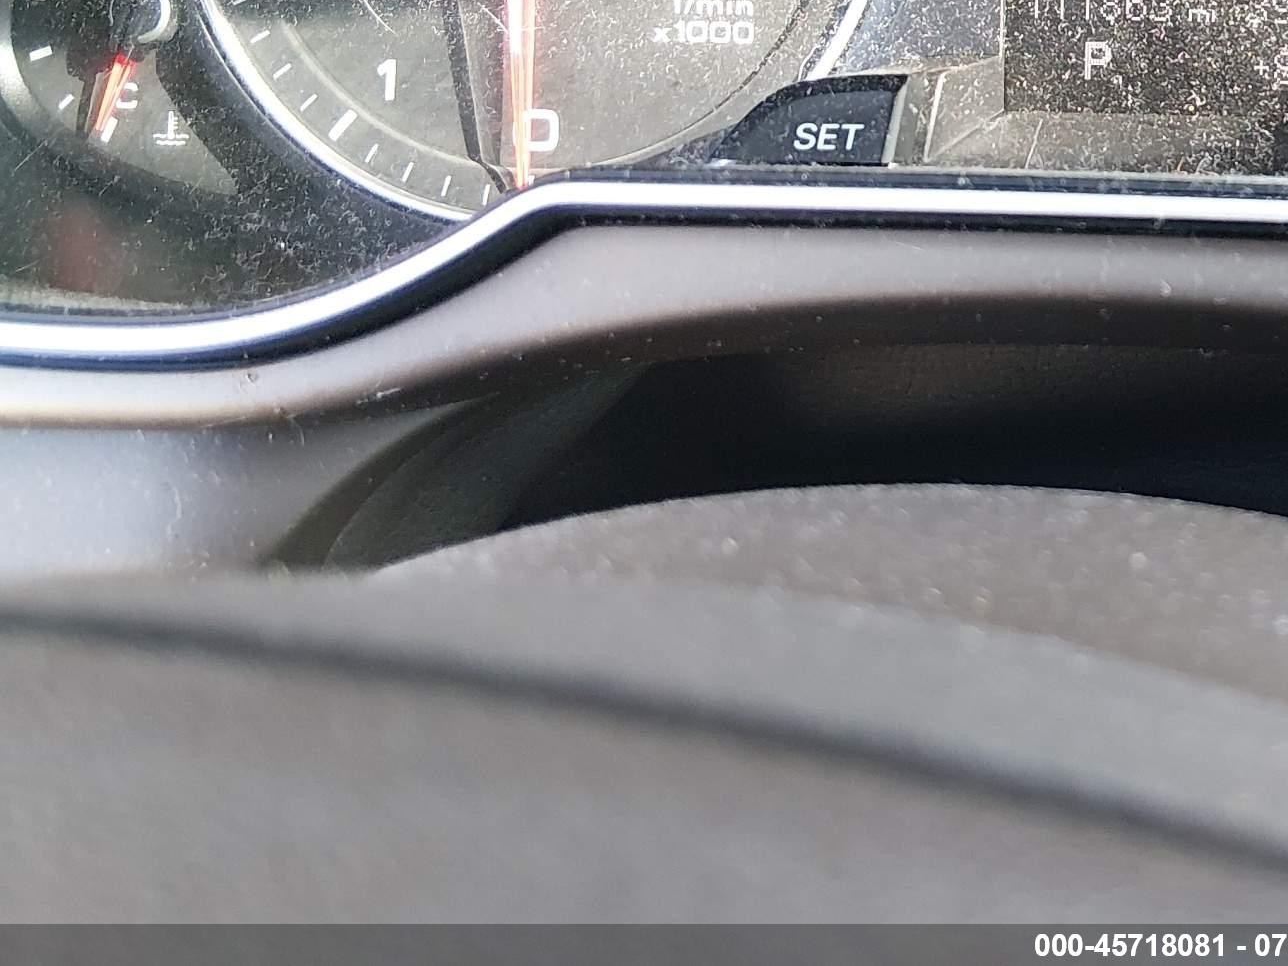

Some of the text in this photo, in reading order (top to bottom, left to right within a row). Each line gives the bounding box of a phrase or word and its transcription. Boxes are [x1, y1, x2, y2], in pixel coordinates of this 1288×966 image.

[651, 19, 756, 45] x1000
[1084, 40, 1112, 81] P
[376, 58, 397, 102] 1
[793, 122, 866, 151] SET
